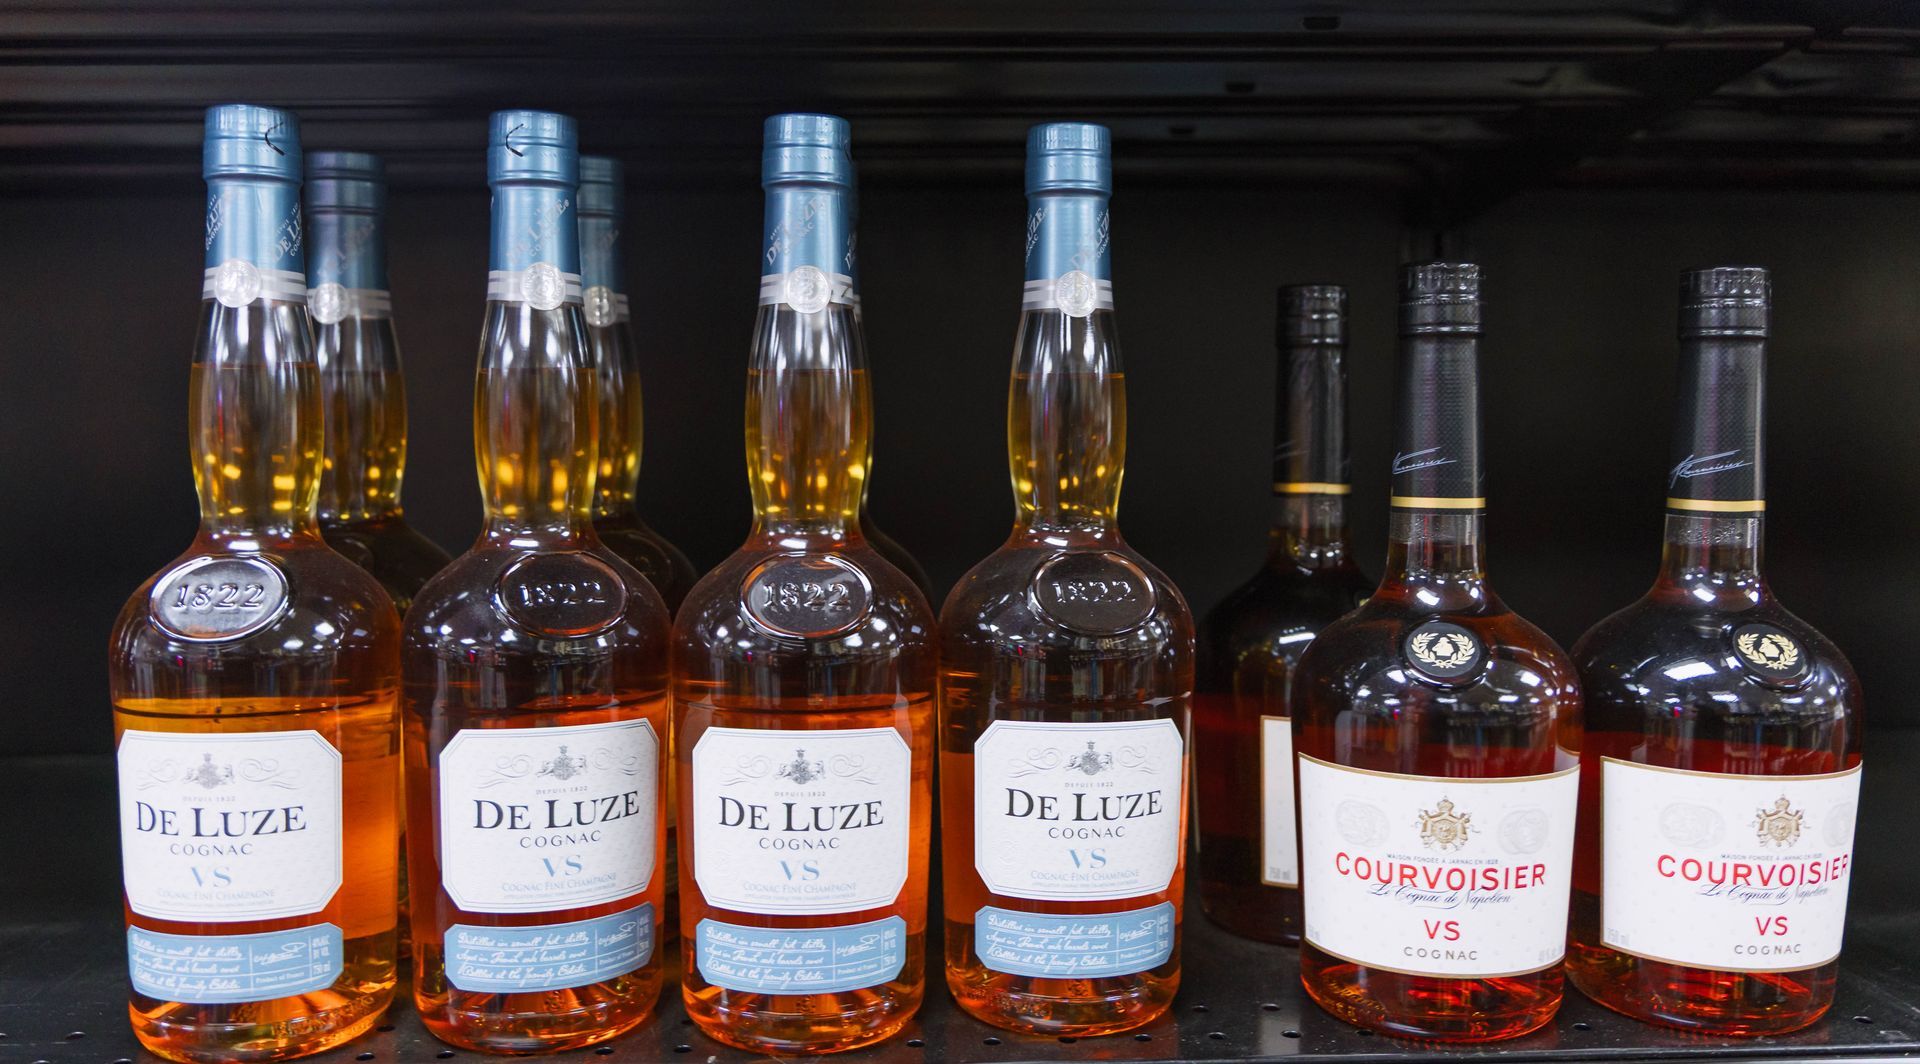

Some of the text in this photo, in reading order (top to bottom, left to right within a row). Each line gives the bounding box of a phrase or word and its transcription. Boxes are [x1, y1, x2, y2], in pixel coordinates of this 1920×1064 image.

[172, 584, 264, 609] 1822
[520, 582, 605, 606] 1822
[763, 582, 849, 607] 1822
[1053, 581, 1135, 603] 1822
[473, 790, 640, 830] DE LUZE
[718, 796, 884, 832] DE LUZE
[1005, 787, 1162, 821] DE LUZE
[135, 801, 307, 838] DE LUZE
[519, 830, 601, 848] COGNAC
[759, 837, 840, 850] COGNAC
[1048, 826, 1126, 839] COGNAC
[170, 843, 253, 856] COGNAC
[1069, 848, 1107, 869] VS
[191, 866, 232, 888] VS
[542, 854, 583, 878] VS
[780, 860, 820, 881] VS
[1335, 852, 1546, 891] COURVOISIER
[1657, 854, 1848, 887] COURVOISIER
[1368, 881, 1391, 896] Le
[1394, 884, 1441, 905] Cognac
[1444, 891, 1458, 903] de
[1697, 881, 1721, 896] Le
[1727, 884, 1772, 904] Cognac
[1423, 919, 1460, 941] VS
[1755, 916, 1788, 936] VS
[1404, 946, 1478, 961] COGNAC
[1734, 944, 1801, 955] COGNAC
